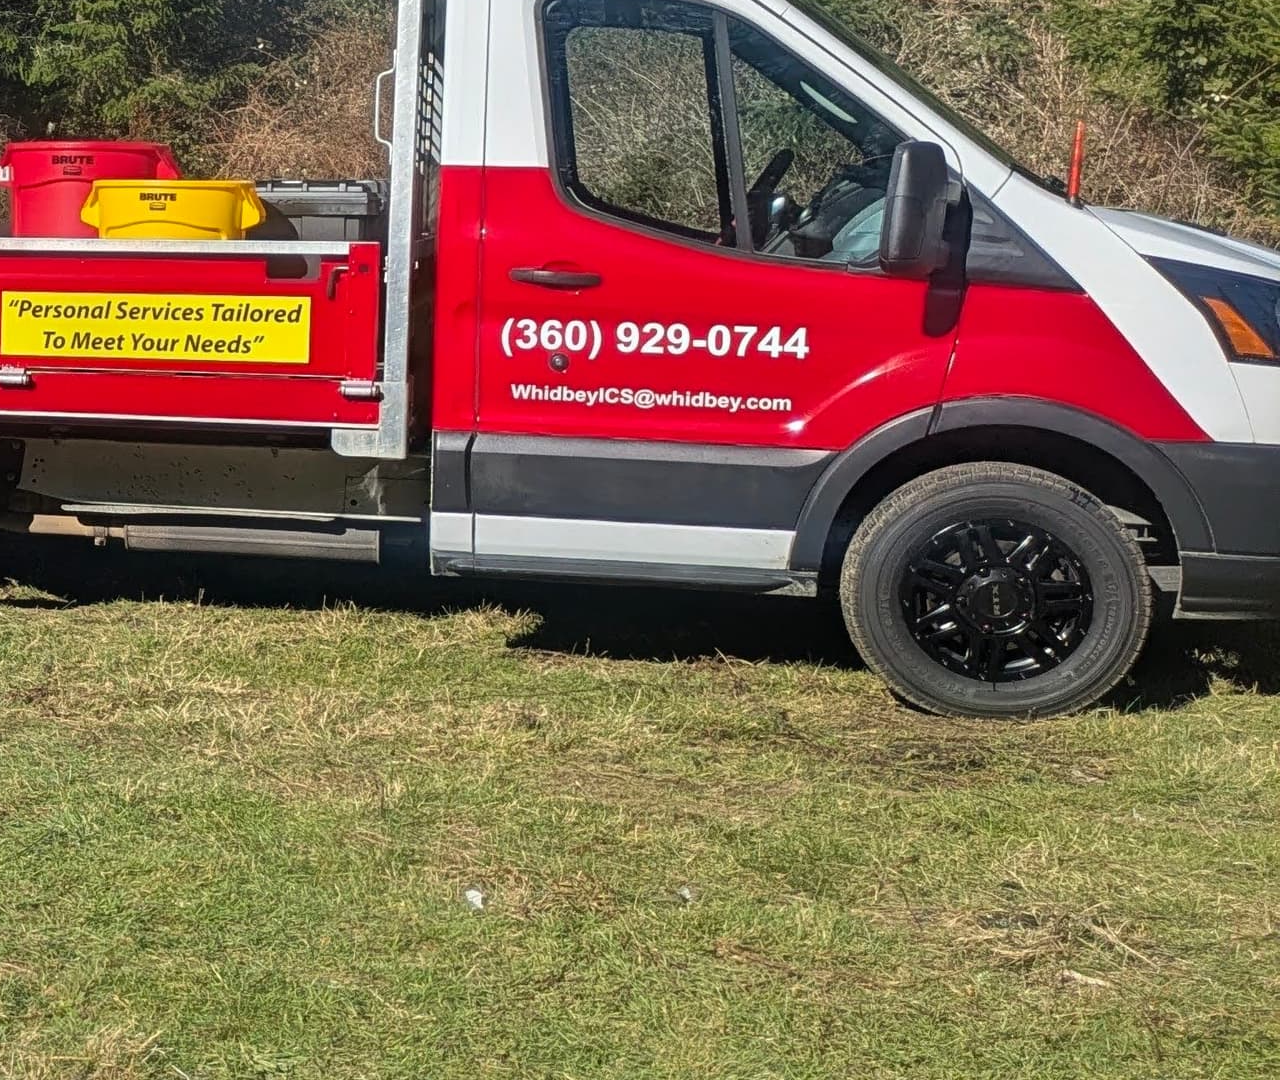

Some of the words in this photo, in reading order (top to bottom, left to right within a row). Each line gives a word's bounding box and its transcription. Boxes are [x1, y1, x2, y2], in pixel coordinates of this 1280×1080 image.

[52, 155, 95, 165] BRUTE
[139, 192, 177, 201] BRUTE
[8, 299, 111, 320] “Personal
[116, 301, 204, 322] Services
[211, 303, 302, 324] Tailored
[42, 331, 65, 350] To
[71, 332, 124, 351] Meet
[130, 333, 179, 353] Your
[184, 334, 265, 355] Needs”
[501, 318, 602, 360] (360)
[616, 321, 810, 359] 929-0744
[510, 383, 792, 413] WhidbeyICS@whidbey.com
